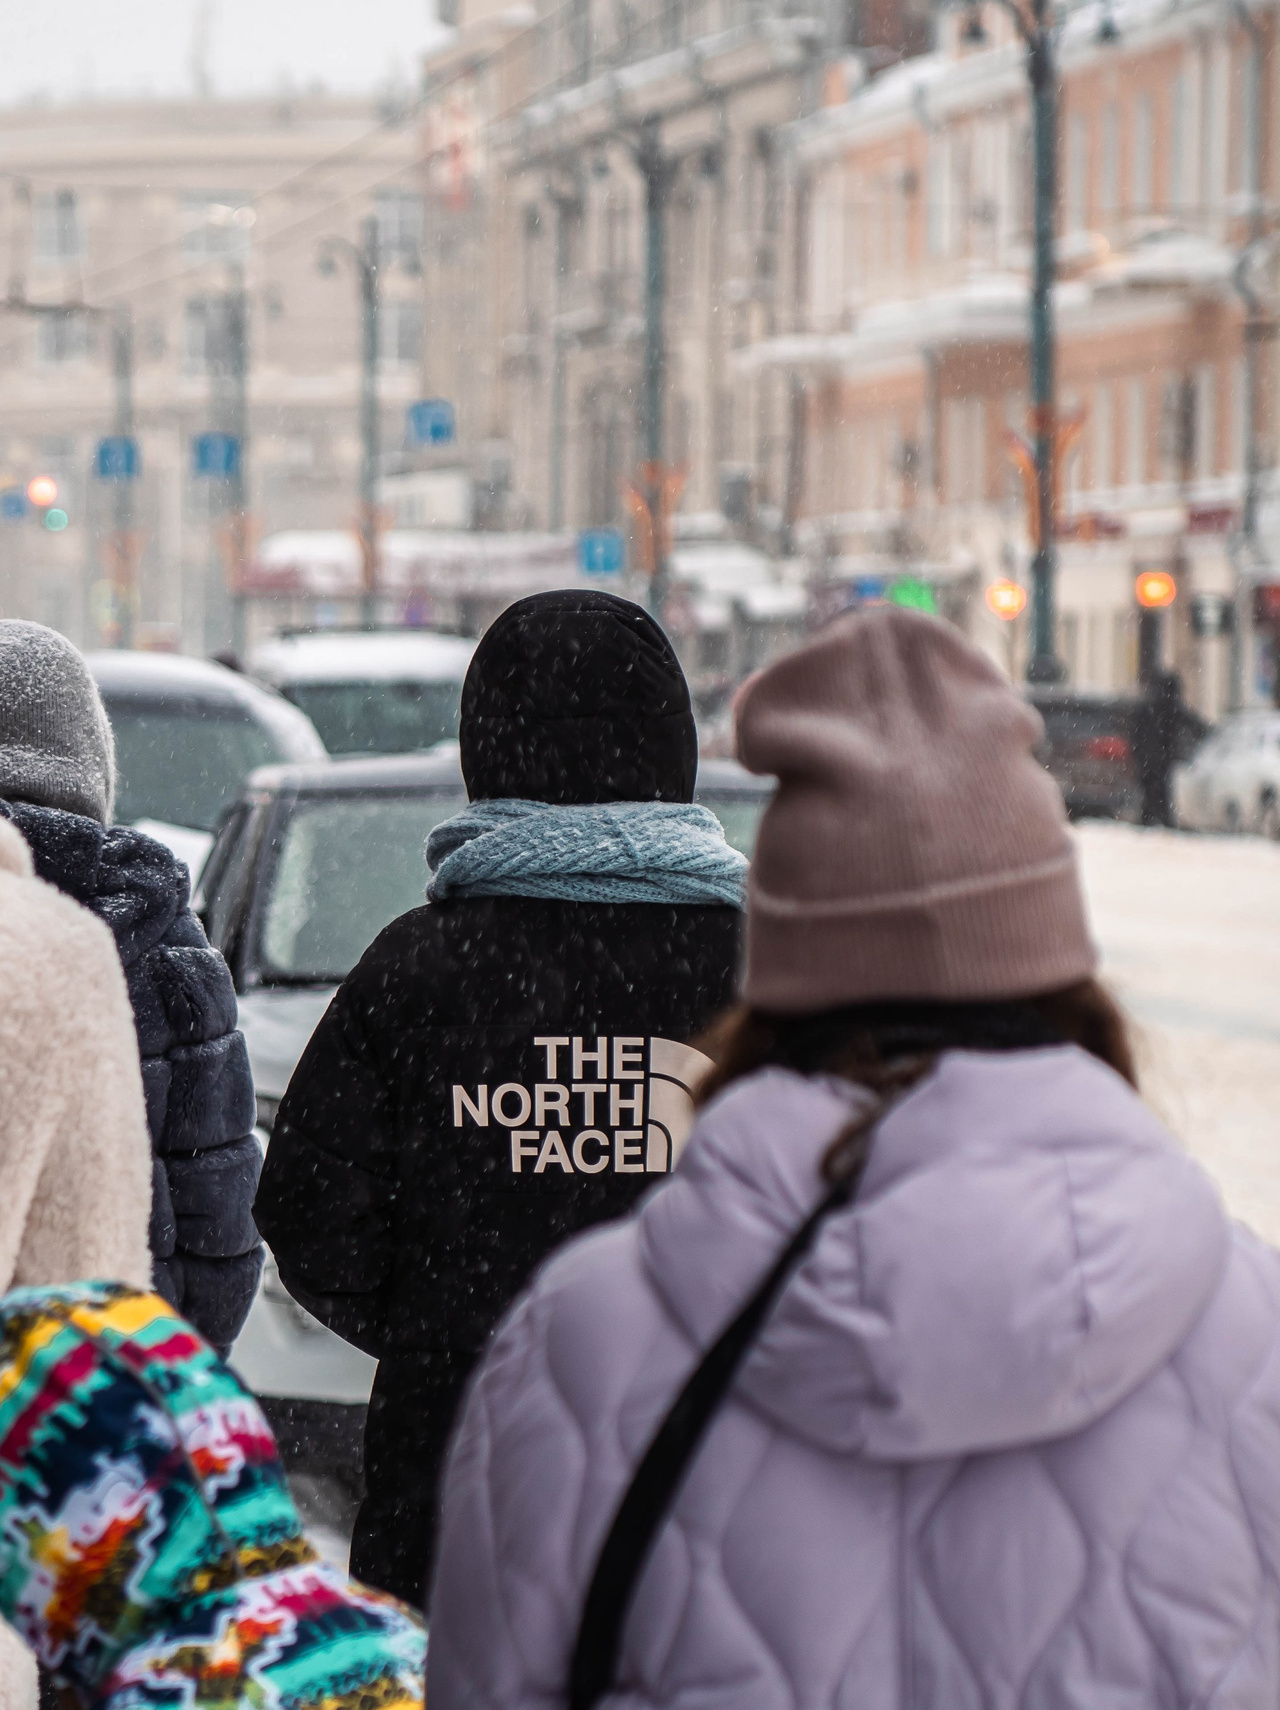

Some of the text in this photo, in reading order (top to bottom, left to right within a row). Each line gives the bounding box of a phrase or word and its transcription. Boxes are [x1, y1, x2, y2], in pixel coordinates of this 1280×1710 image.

[534, 1036, 645, 1080] THE
[452, 1082, 644, 1127] NORTH
[511, 1129, 645, 1174] FACE
